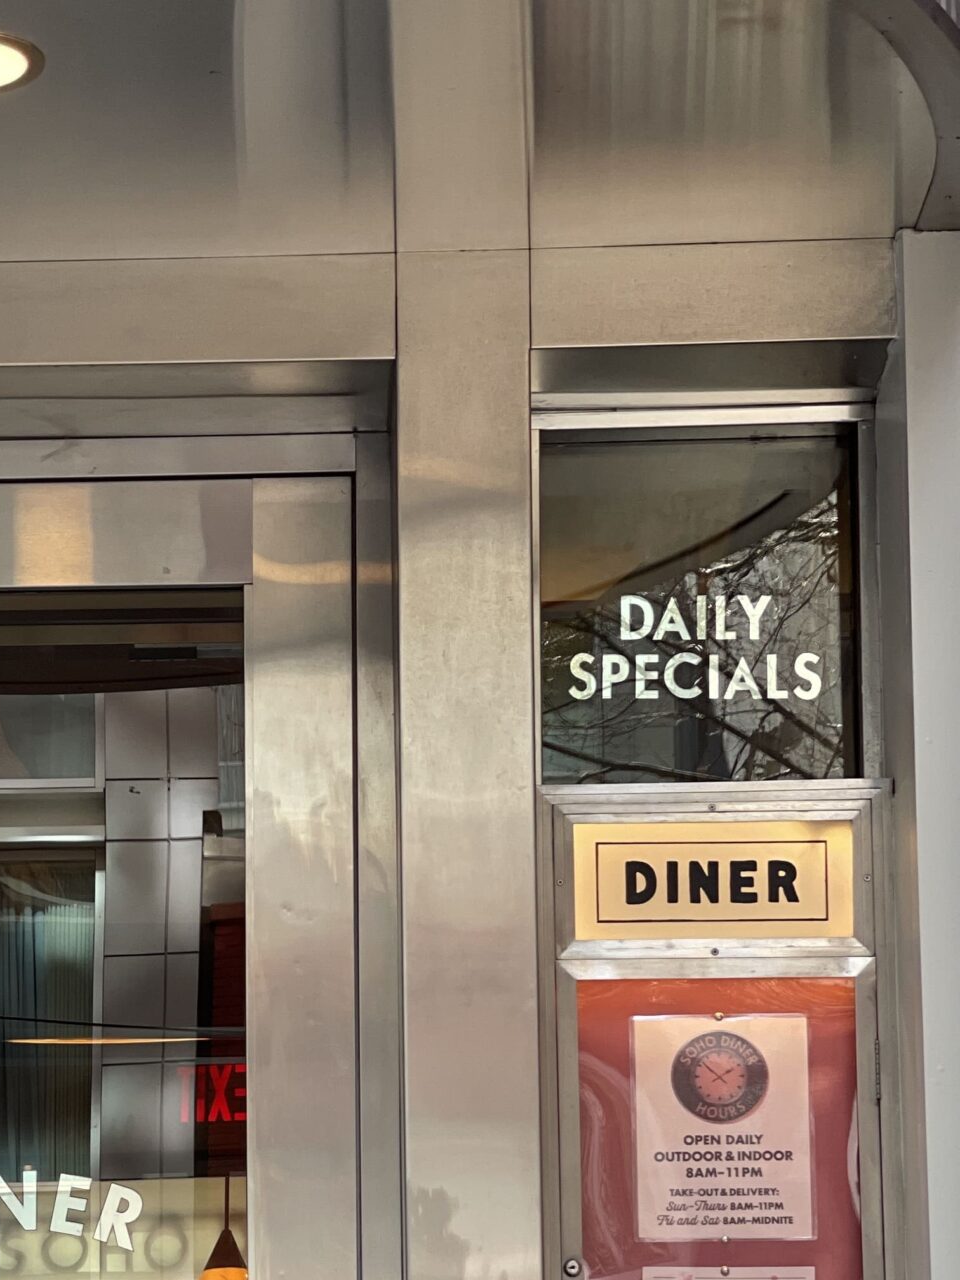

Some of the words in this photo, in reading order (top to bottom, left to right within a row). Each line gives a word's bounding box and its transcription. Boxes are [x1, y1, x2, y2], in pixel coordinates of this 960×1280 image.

[619, 594, 773, 641] DAILY
[567, 652, 823, 701] SPECIALS
[624, 859, 800, 906] DINER
[679, 1036, 718, 1066] SOHO
[720, 1036, 762, 1066] DINER
[695, 1101, 747, 1120] HOURS
[683, 1134, 722, 1146] OPEN
[725, 1134, 764, 1145] DAILY
[653, 1150, 723, 1163] OUTDOOR
[725, 1150, 735, 1162] &
[737, 1150, 794, 1162] INDOOR
[656, 1214, 675, 1226] Fri
[677, 1215, 698, 1226] and
[701, 1214, 721, 1226] Sat
